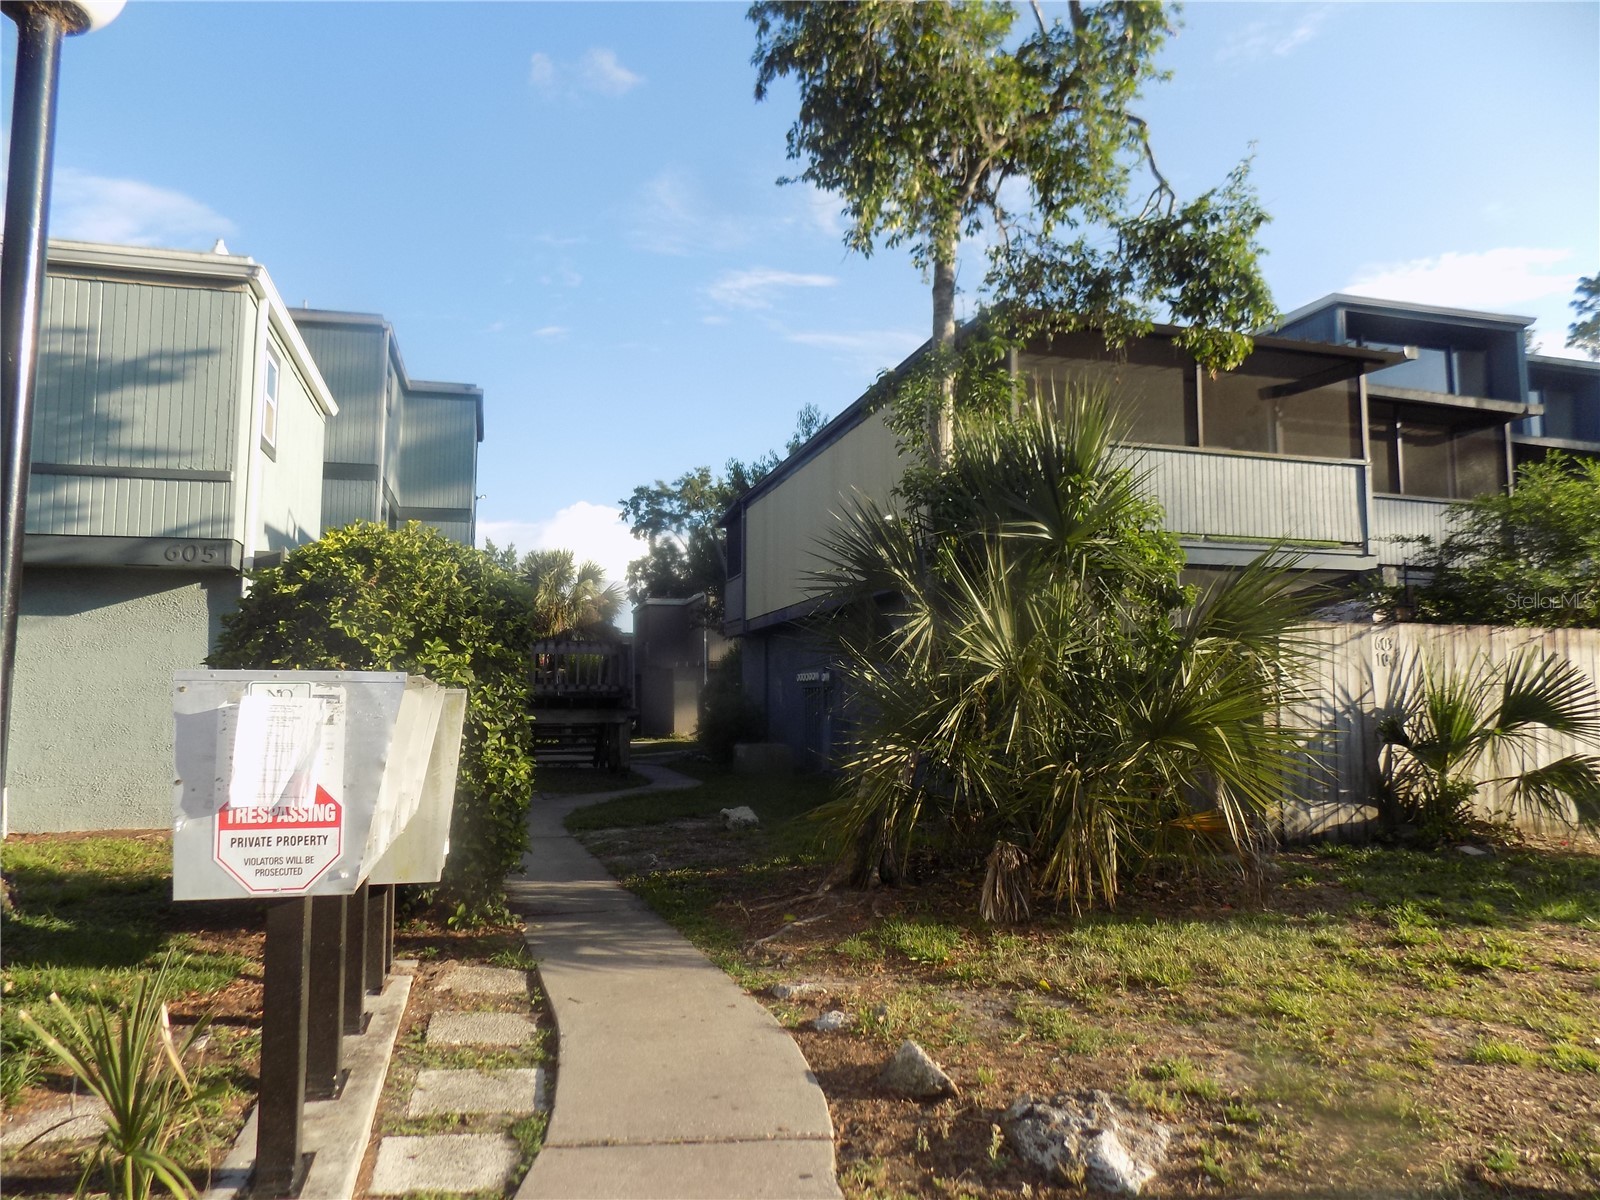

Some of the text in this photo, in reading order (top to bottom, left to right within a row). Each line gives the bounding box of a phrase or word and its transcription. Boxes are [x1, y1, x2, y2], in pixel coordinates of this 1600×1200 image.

[164, 545, 218, 563] 605
[227, 804, 337, 824] TRESPASSING
[230, 835, 329, 848] PRIVATE PROPERTY
[244, 856, 315, 866] VIOLATORS WILL BE
[255, 867, 303, 877] PROSECUTED
